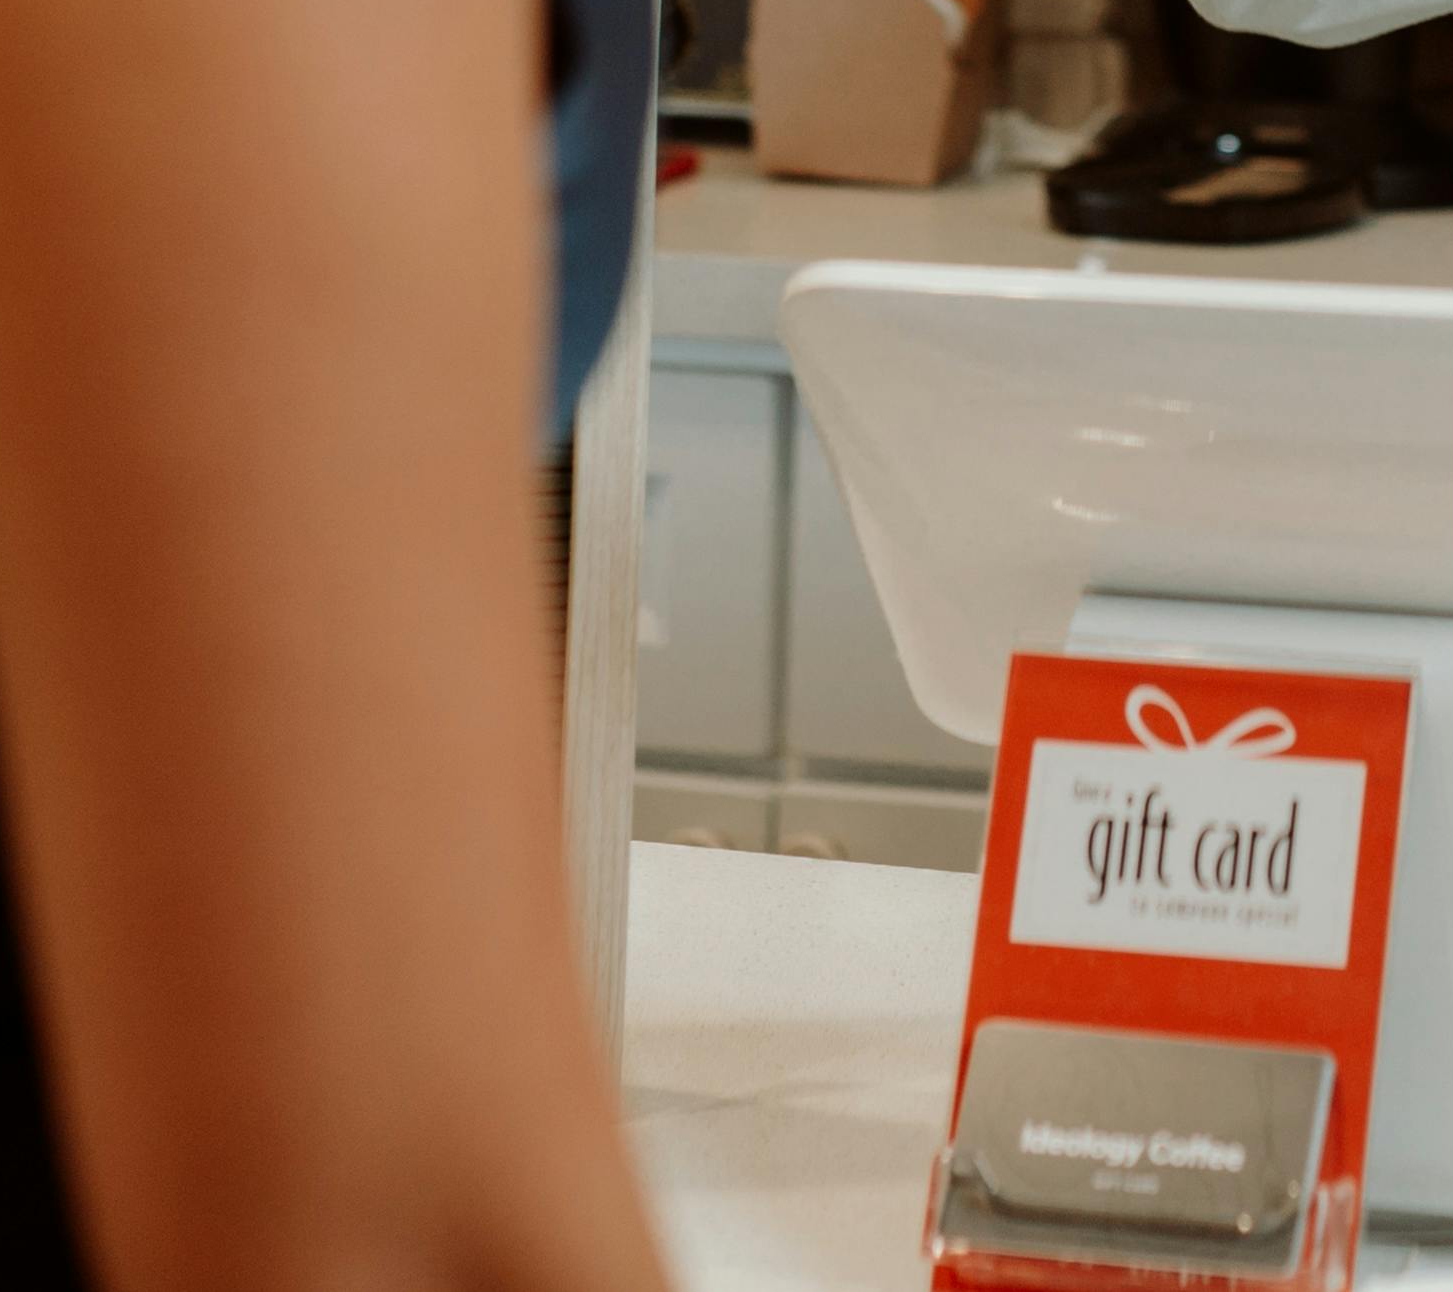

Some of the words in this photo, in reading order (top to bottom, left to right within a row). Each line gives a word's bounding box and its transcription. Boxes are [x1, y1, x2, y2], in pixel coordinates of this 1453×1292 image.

[1085, 782, 1174, 906] gift
[1191, 795, 1299, 896] card
[1148, 1129, 1246, 1173] Coffee
